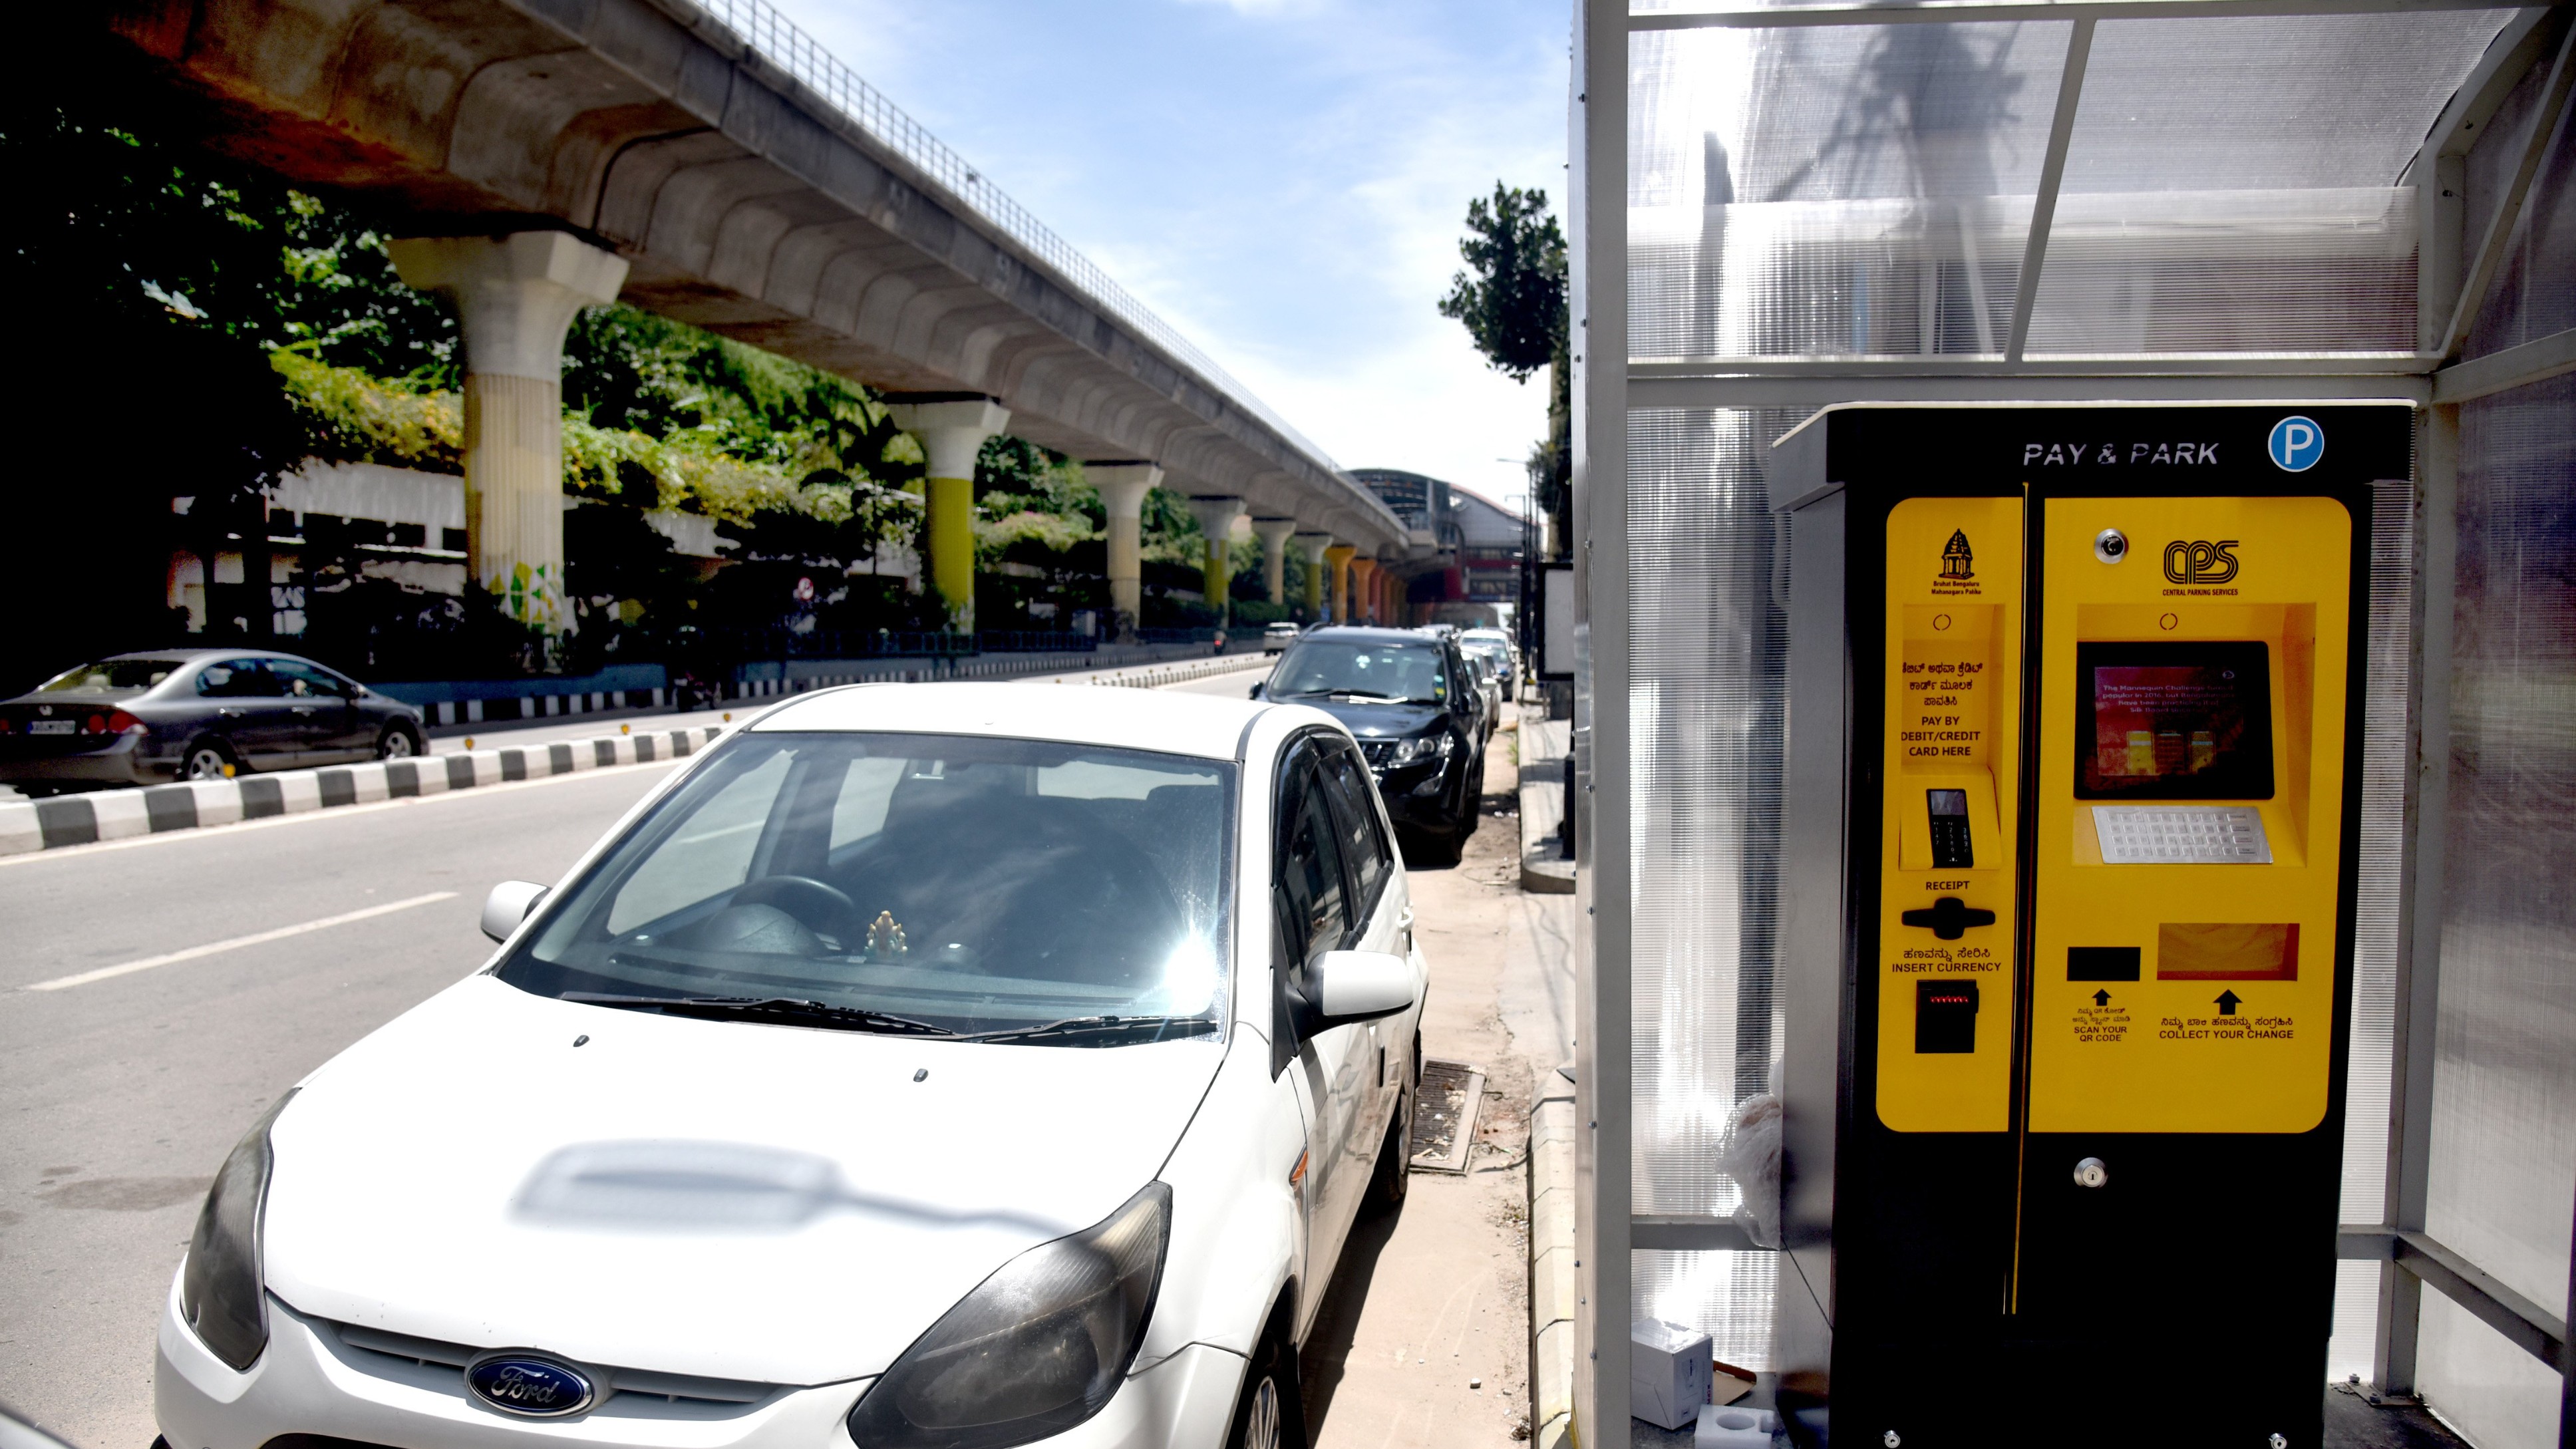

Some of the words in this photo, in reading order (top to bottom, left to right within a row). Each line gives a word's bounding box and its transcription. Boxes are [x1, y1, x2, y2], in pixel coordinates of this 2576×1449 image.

[2285, 424, 2314, 464] P
[2023, 444, 2086, 465] PAY
[2098, 444, 2116, 464] &
[2130, 443, 2219, 464] PARK
[2164, 540, 2239, 584] CPS
[1921, 716, 1942, 726] PAY
[1945, 716, 1960, 726] BY
[1901, 731, 1981, 742] DEBIT/CREDIT
[1909, 746, 1939, 756] CARD
[1942, 746, 1971, 756] HERE
[1926, 881, 1970, 890] RECEIPT
[1903, 947, 1953, 962] ಹಣವನ್ನು
[1892, 963, 1933, 972] INSERT
[1937, 963, 2001, 972] CURRENCY
[2247, 1030, 2294, 1039] CHANGE
[491, 1366, 560, 1403] Ford
